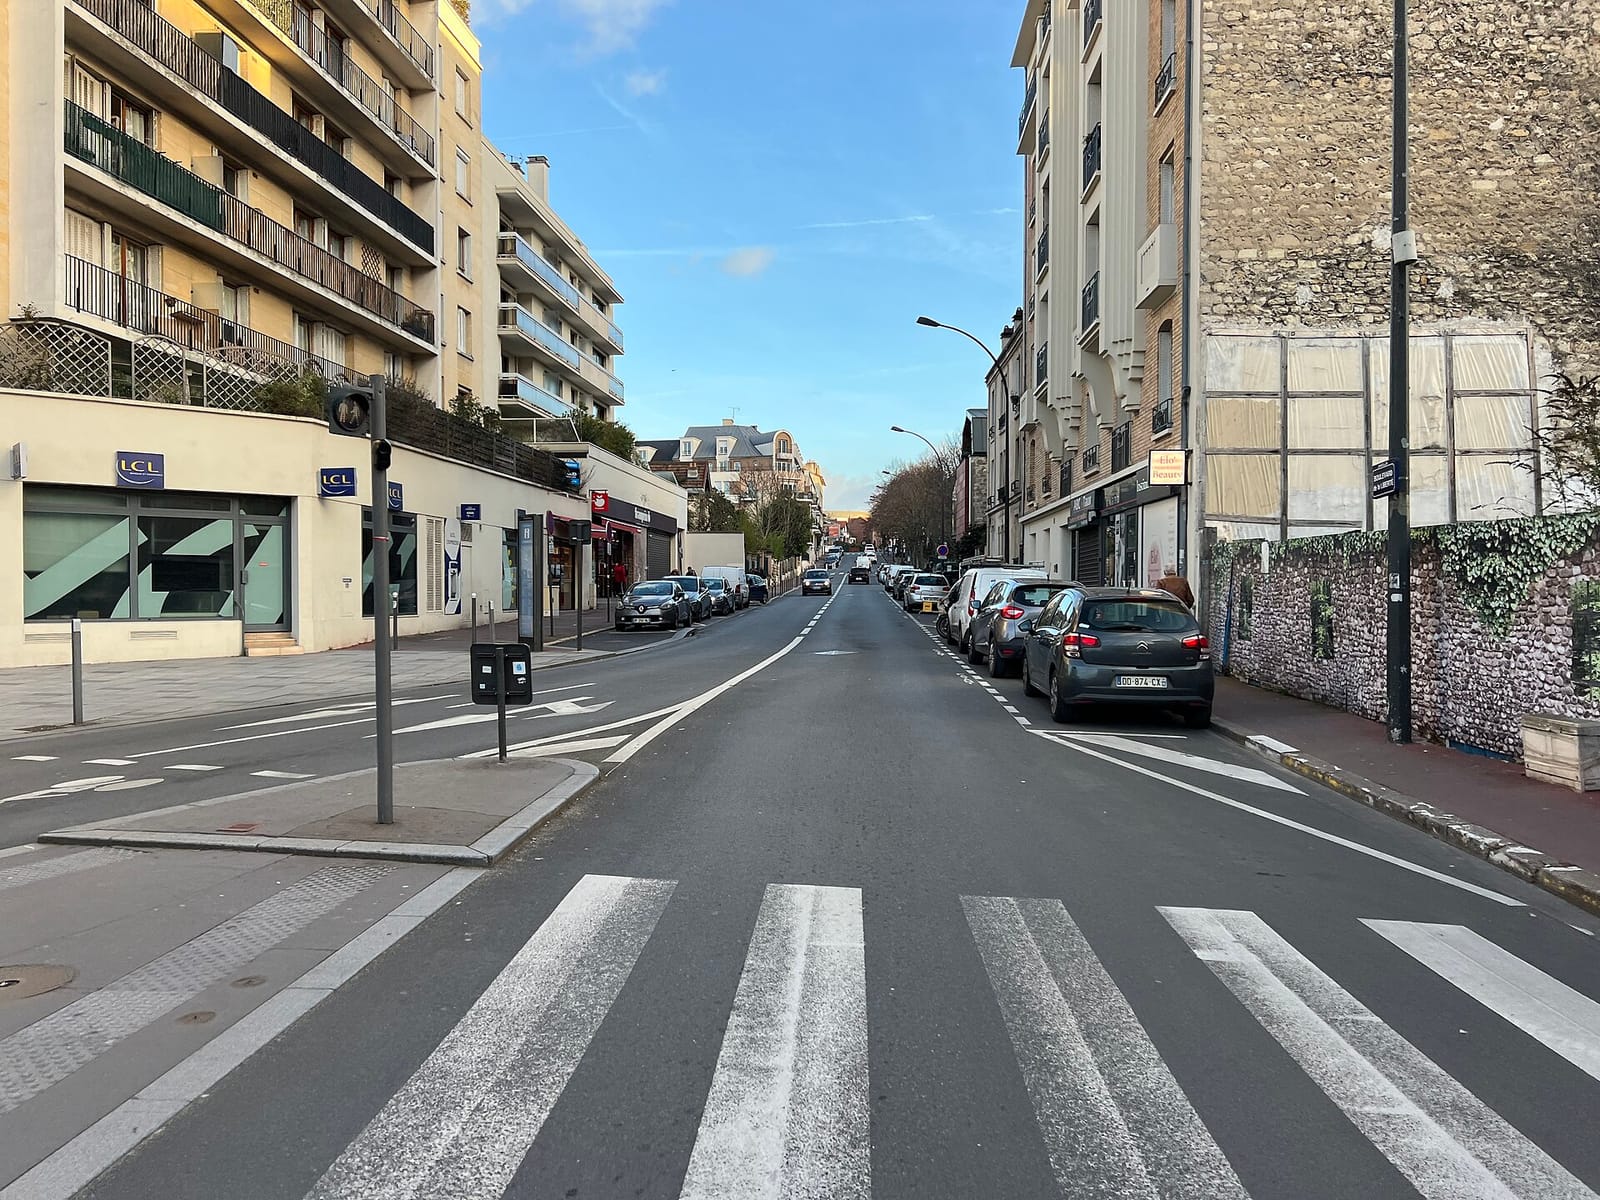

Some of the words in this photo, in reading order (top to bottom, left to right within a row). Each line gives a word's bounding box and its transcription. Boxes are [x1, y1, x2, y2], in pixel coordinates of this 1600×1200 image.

[121, 459, 159, 473] LCL
[322, 474, 352, 485] LCL
[1152, 470, 1182, 480] Beauty
[389, 488, 401, 499] LCL
